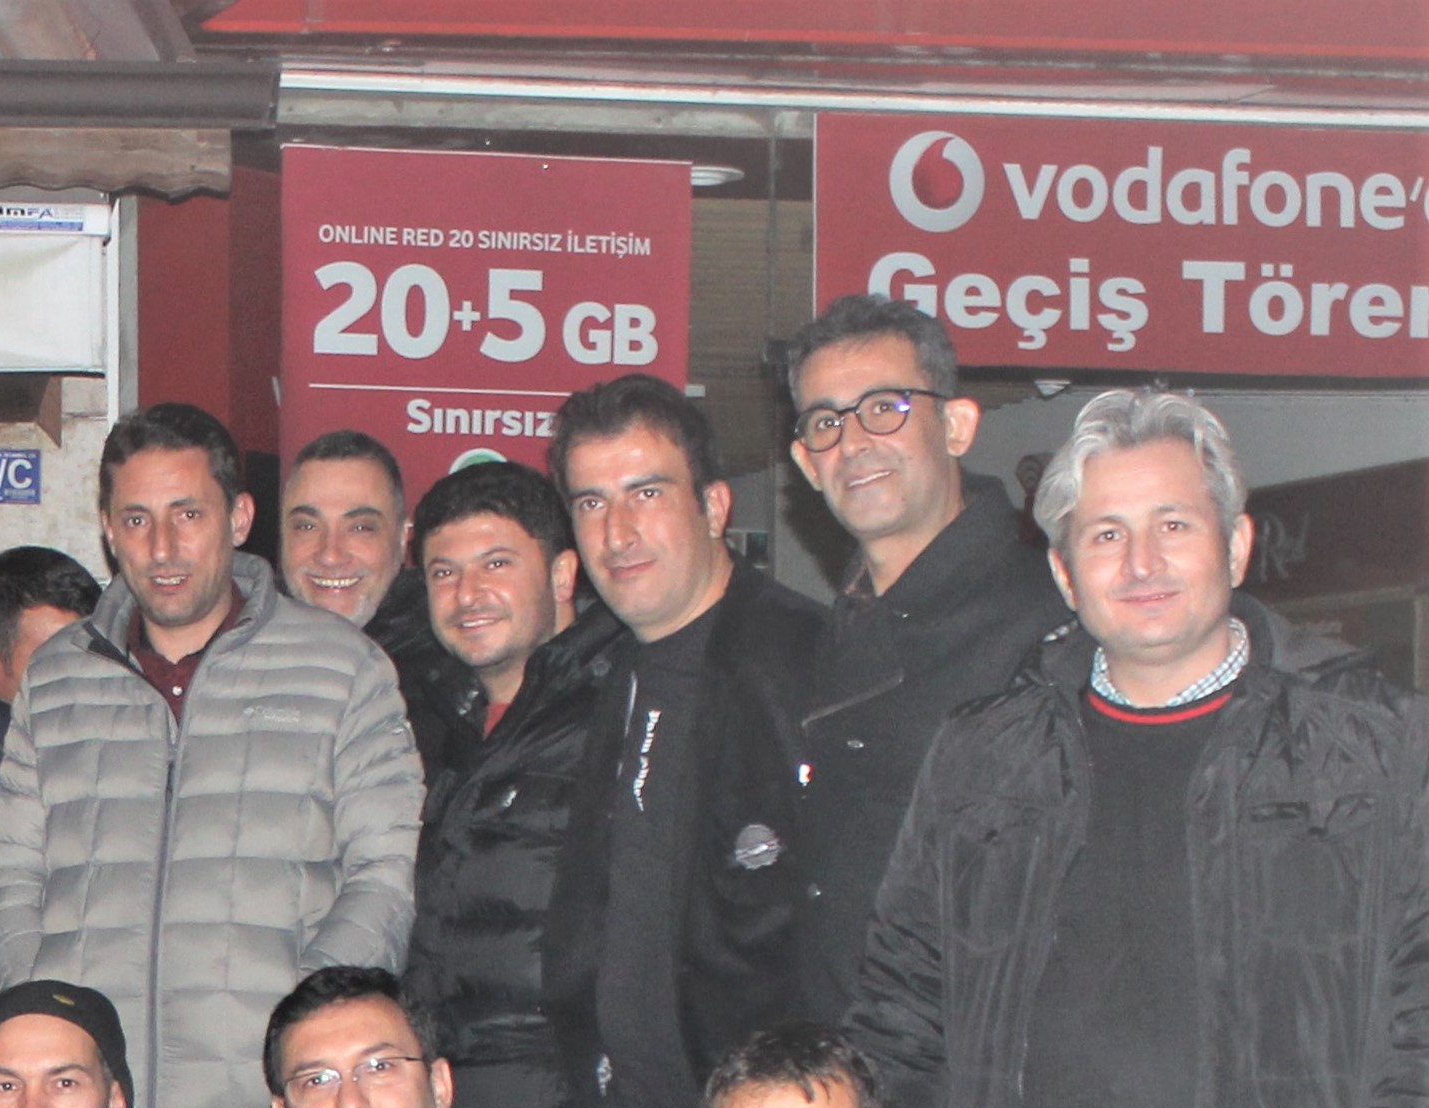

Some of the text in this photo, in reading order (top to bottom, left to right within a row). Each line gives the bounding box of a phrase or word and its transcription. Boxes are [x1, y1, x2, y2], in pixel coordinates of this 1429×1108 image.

[1002, 146, 1429, 230] vodafone'
[318, 225, 652, 258] ONLINE RED 20 SINIRSIZ İLETİŞİM
[313, 261, 658, 365] 20+5 GB
[868, 251, 1150, 353] Geçiş
[406, 399, 557, 438] Sınırsız
